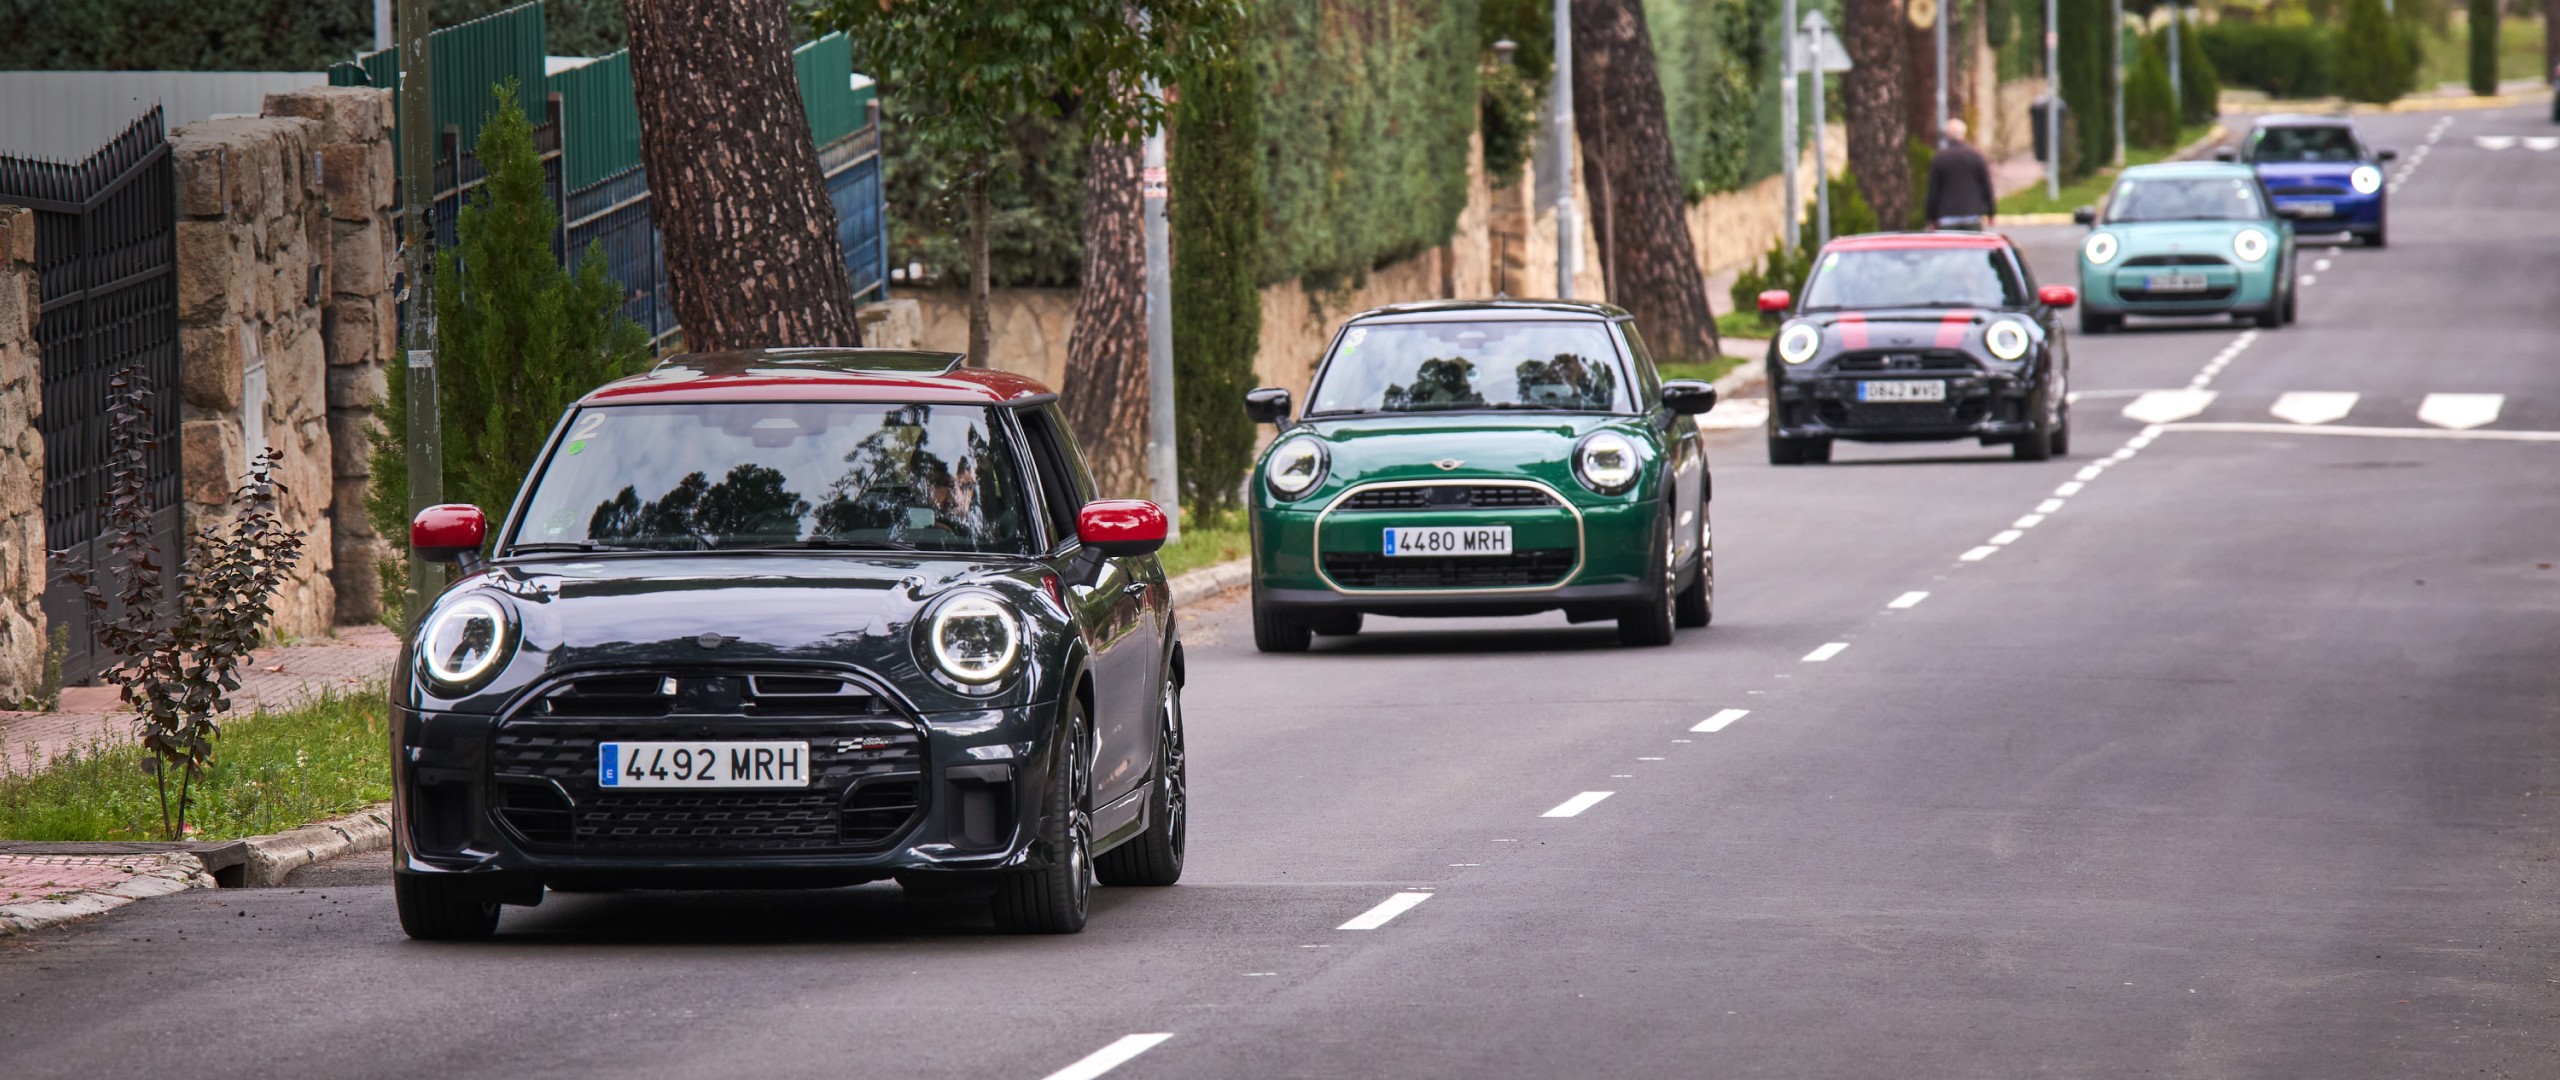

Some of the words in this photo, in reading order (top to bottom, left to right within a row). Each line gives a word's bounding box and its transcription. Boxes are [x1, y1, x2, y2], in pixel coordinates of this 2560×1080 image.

[1345, 328, 1367, 346] 3
[571, 412, 606, 442] 2
[1400, 531, 1455, 551] 4480
[1463, 530, 1505, 551] MRH
[606, 769, 613, 779] E
[625, 748, 716, 781] 4492
[731, 748, 799, 781] MRH
